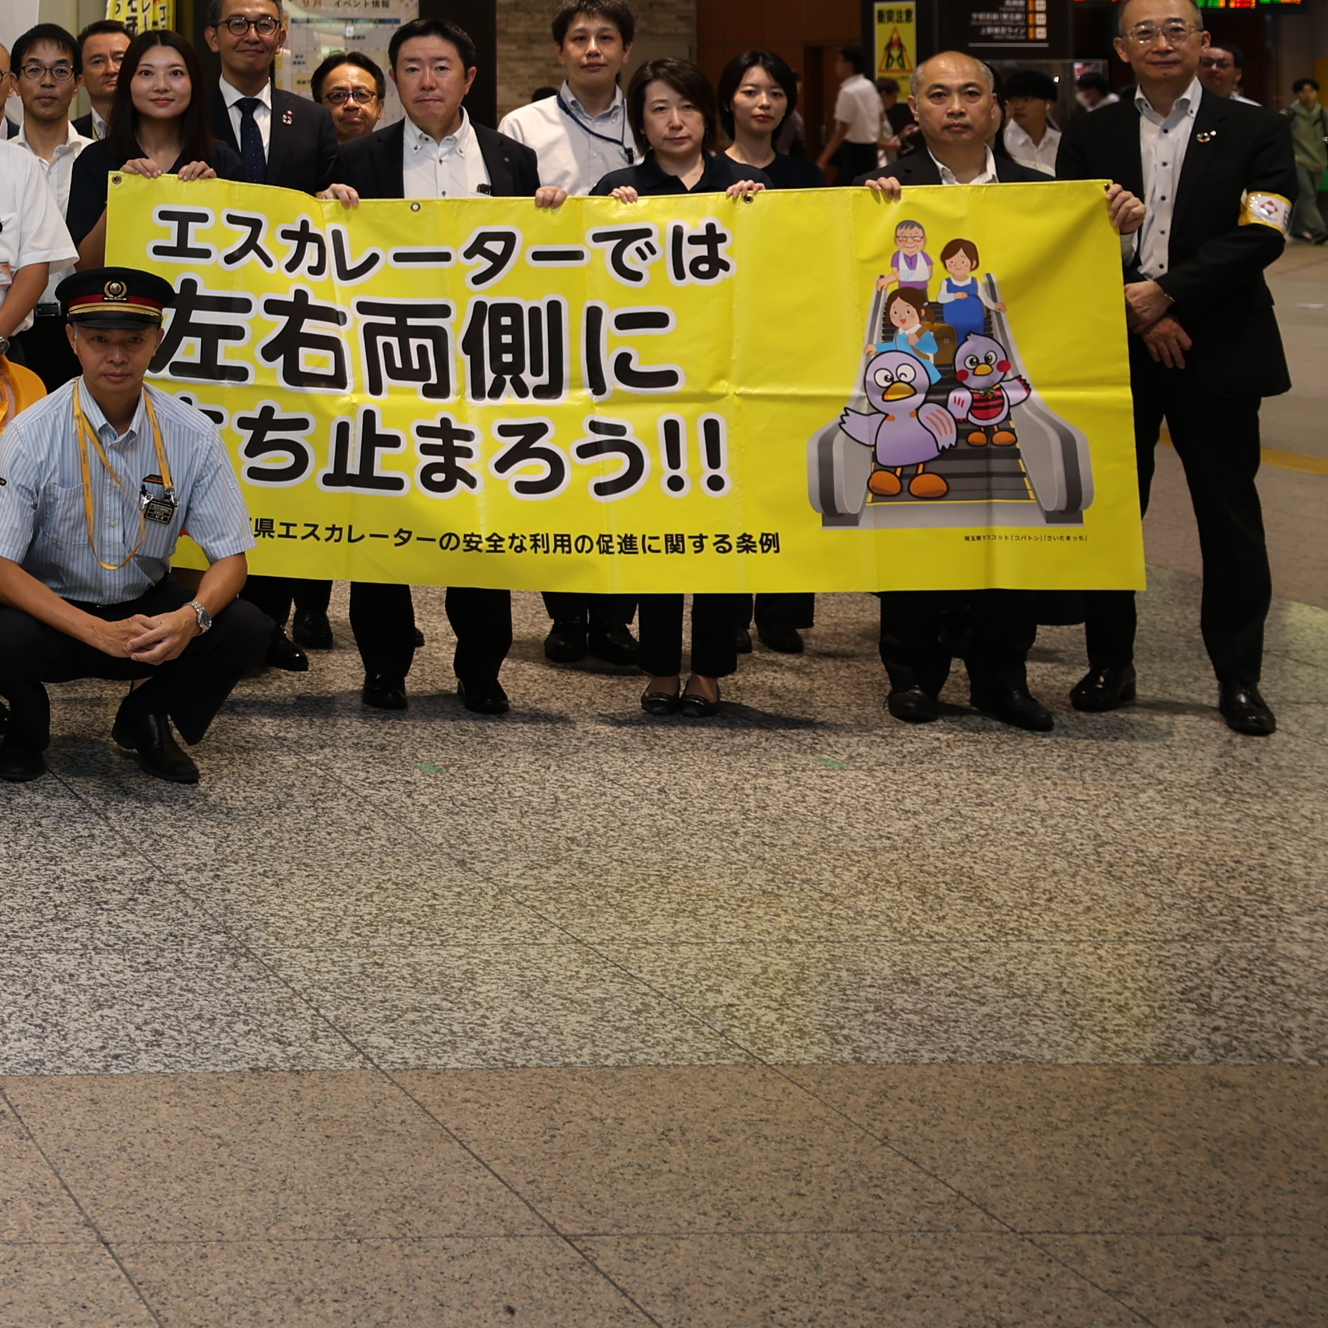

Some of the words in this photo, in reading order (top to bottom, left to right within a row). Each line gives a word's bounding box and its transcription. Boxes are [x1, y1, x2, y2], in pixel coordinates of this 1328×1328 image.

[334, 0, 391, 9] イベント情報
[157, 210, 732, 284] エスカレーターでは
[152, 278, 680, 401] 左右両側に
[189, 397, 729, 496] ち止まろう!!
[249, 516, 781, 556] 県エスカレーターの安全な利用の促進に関する条例
